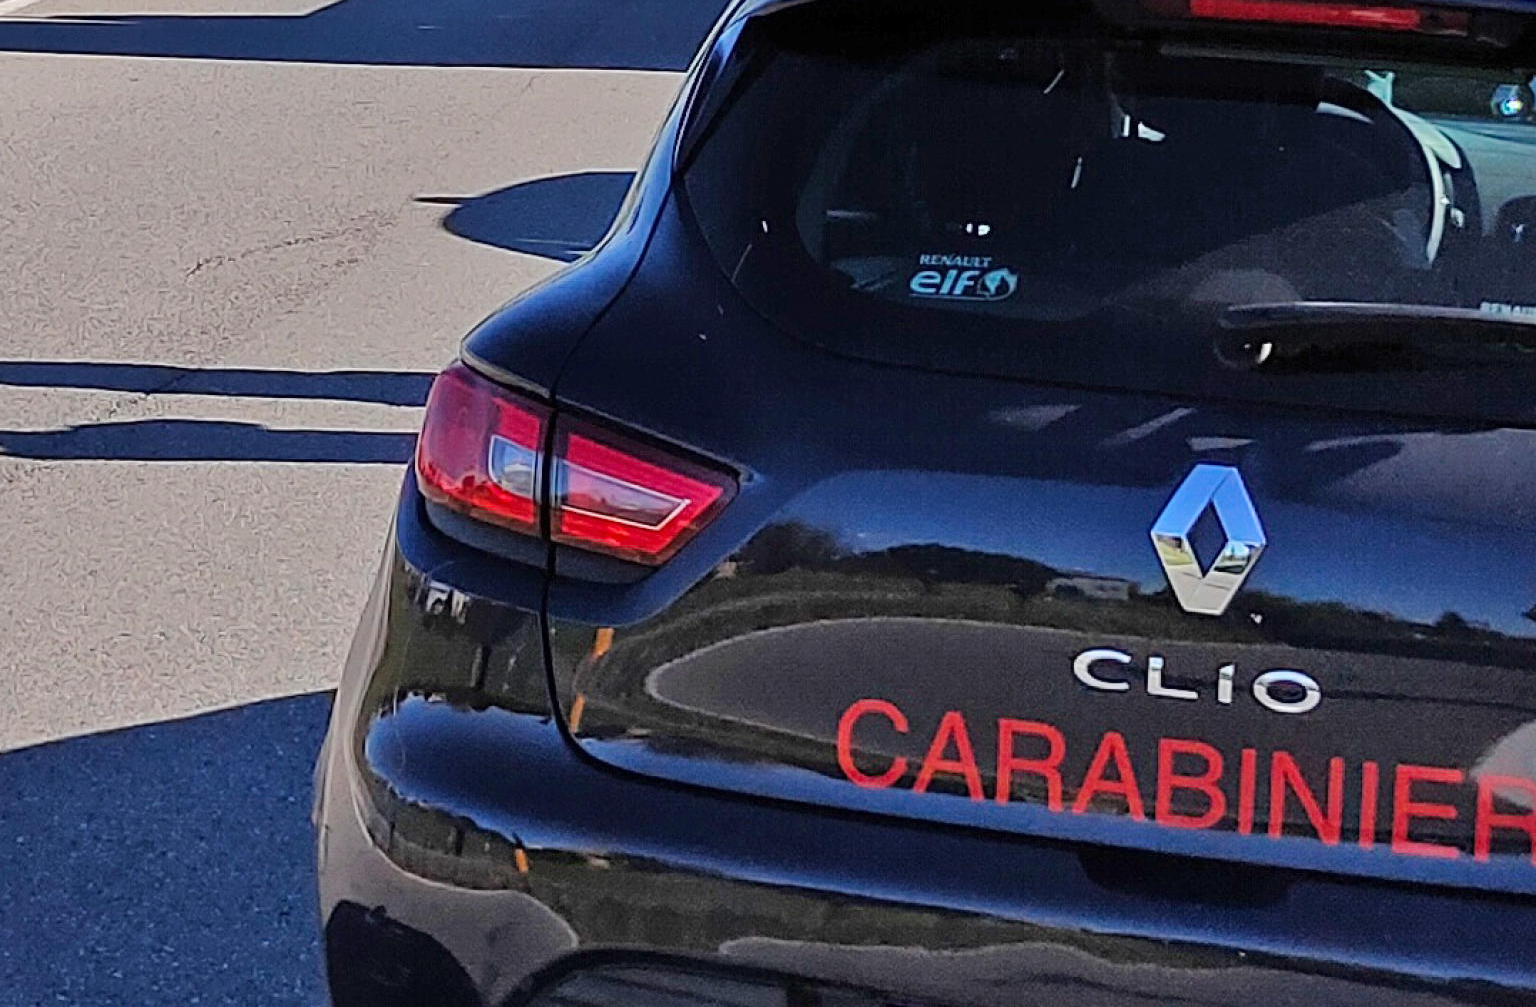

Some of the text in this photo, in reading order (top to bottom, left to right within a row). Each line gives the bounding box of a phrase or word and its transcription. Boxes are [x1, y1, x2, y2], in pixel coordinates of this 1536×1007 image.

[919, 254, 992, 268] RENAULT
[909, 269, 982, 295] elf
[1072, 647, 1323, 714] CLIO
